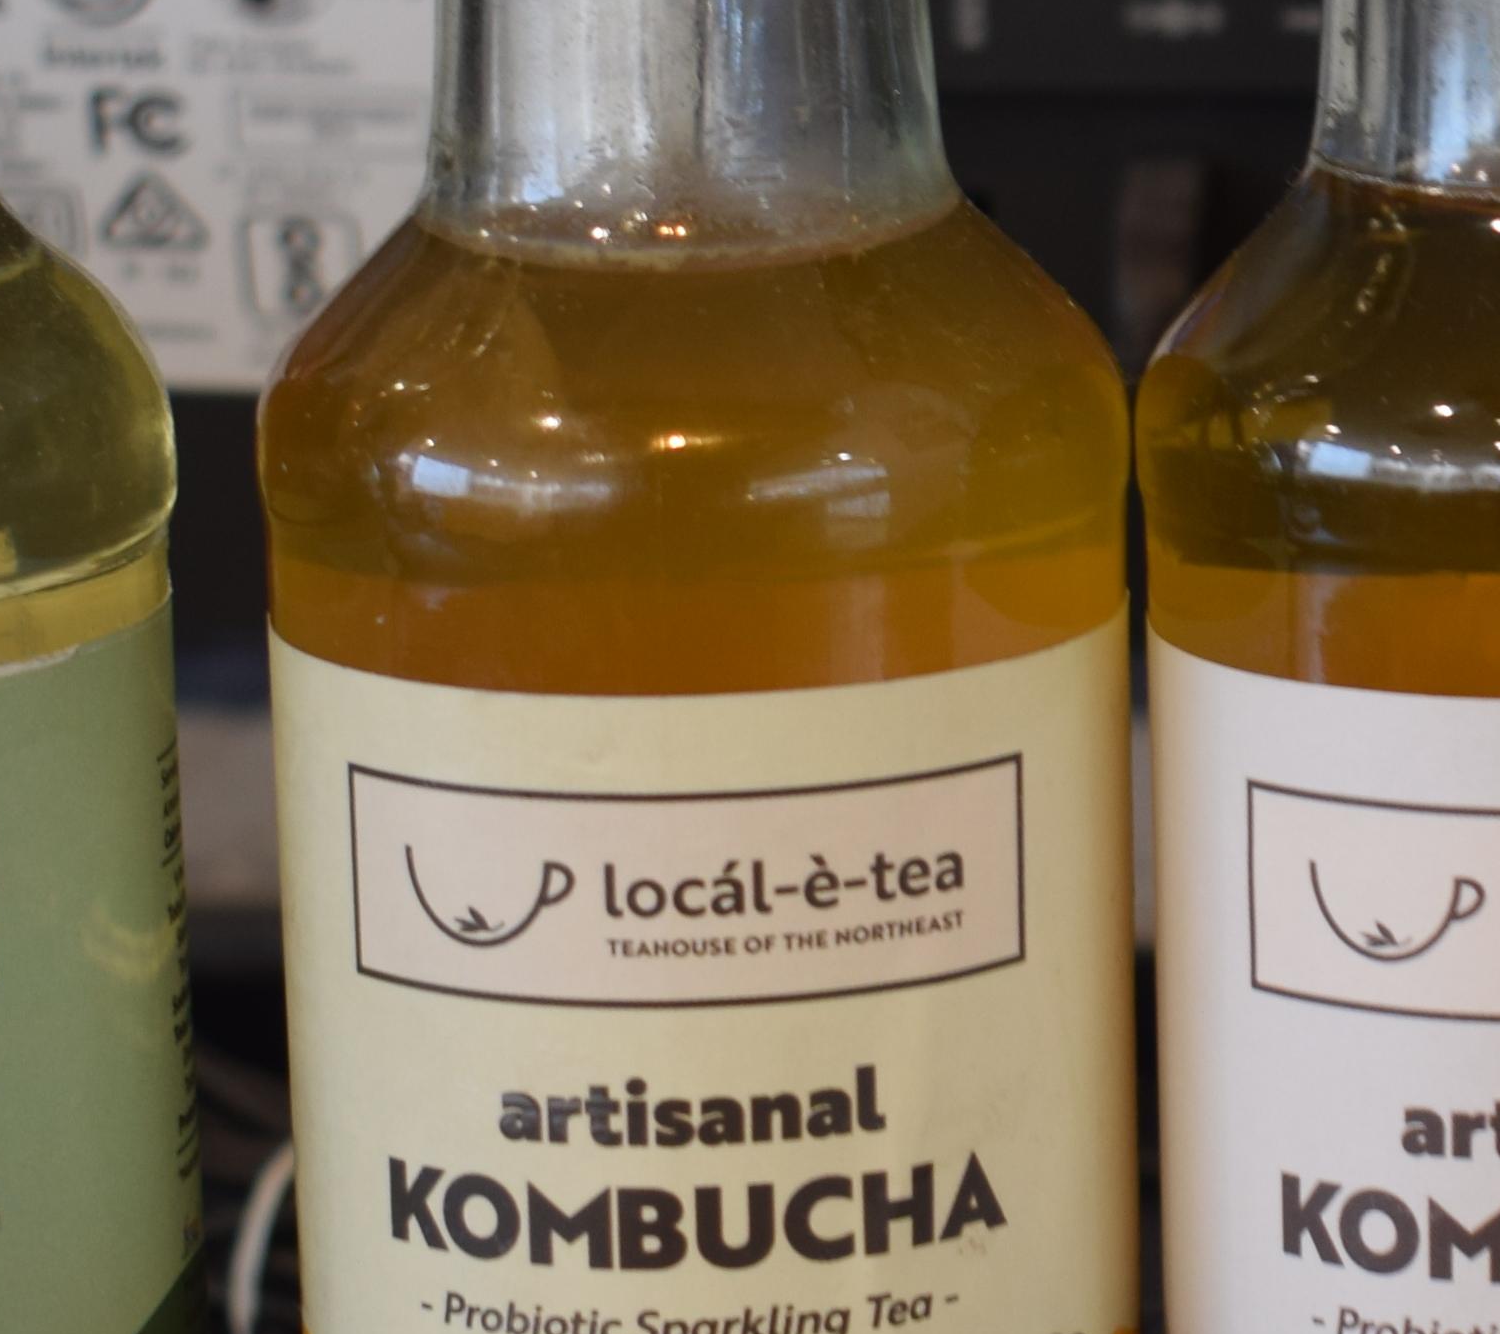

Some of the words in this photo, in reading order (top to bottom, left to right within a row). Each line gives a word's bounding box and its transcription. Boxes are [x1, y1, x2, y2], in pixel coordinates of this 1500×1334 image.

[602, 851, 965, 918] locál-è-tea
[608, 937, 736, 958] TEAHOUSE
[743, 935, 775, 953] OF
[784, 932, 828, 951] THE
[835, 910, 964, 947] NORTHEAST
[499, 1065, 886, 1148] artisanal
[388, 1151, 1008, 1271] KOMBUCHA
[866, 1291, 933, 1330] Tea
